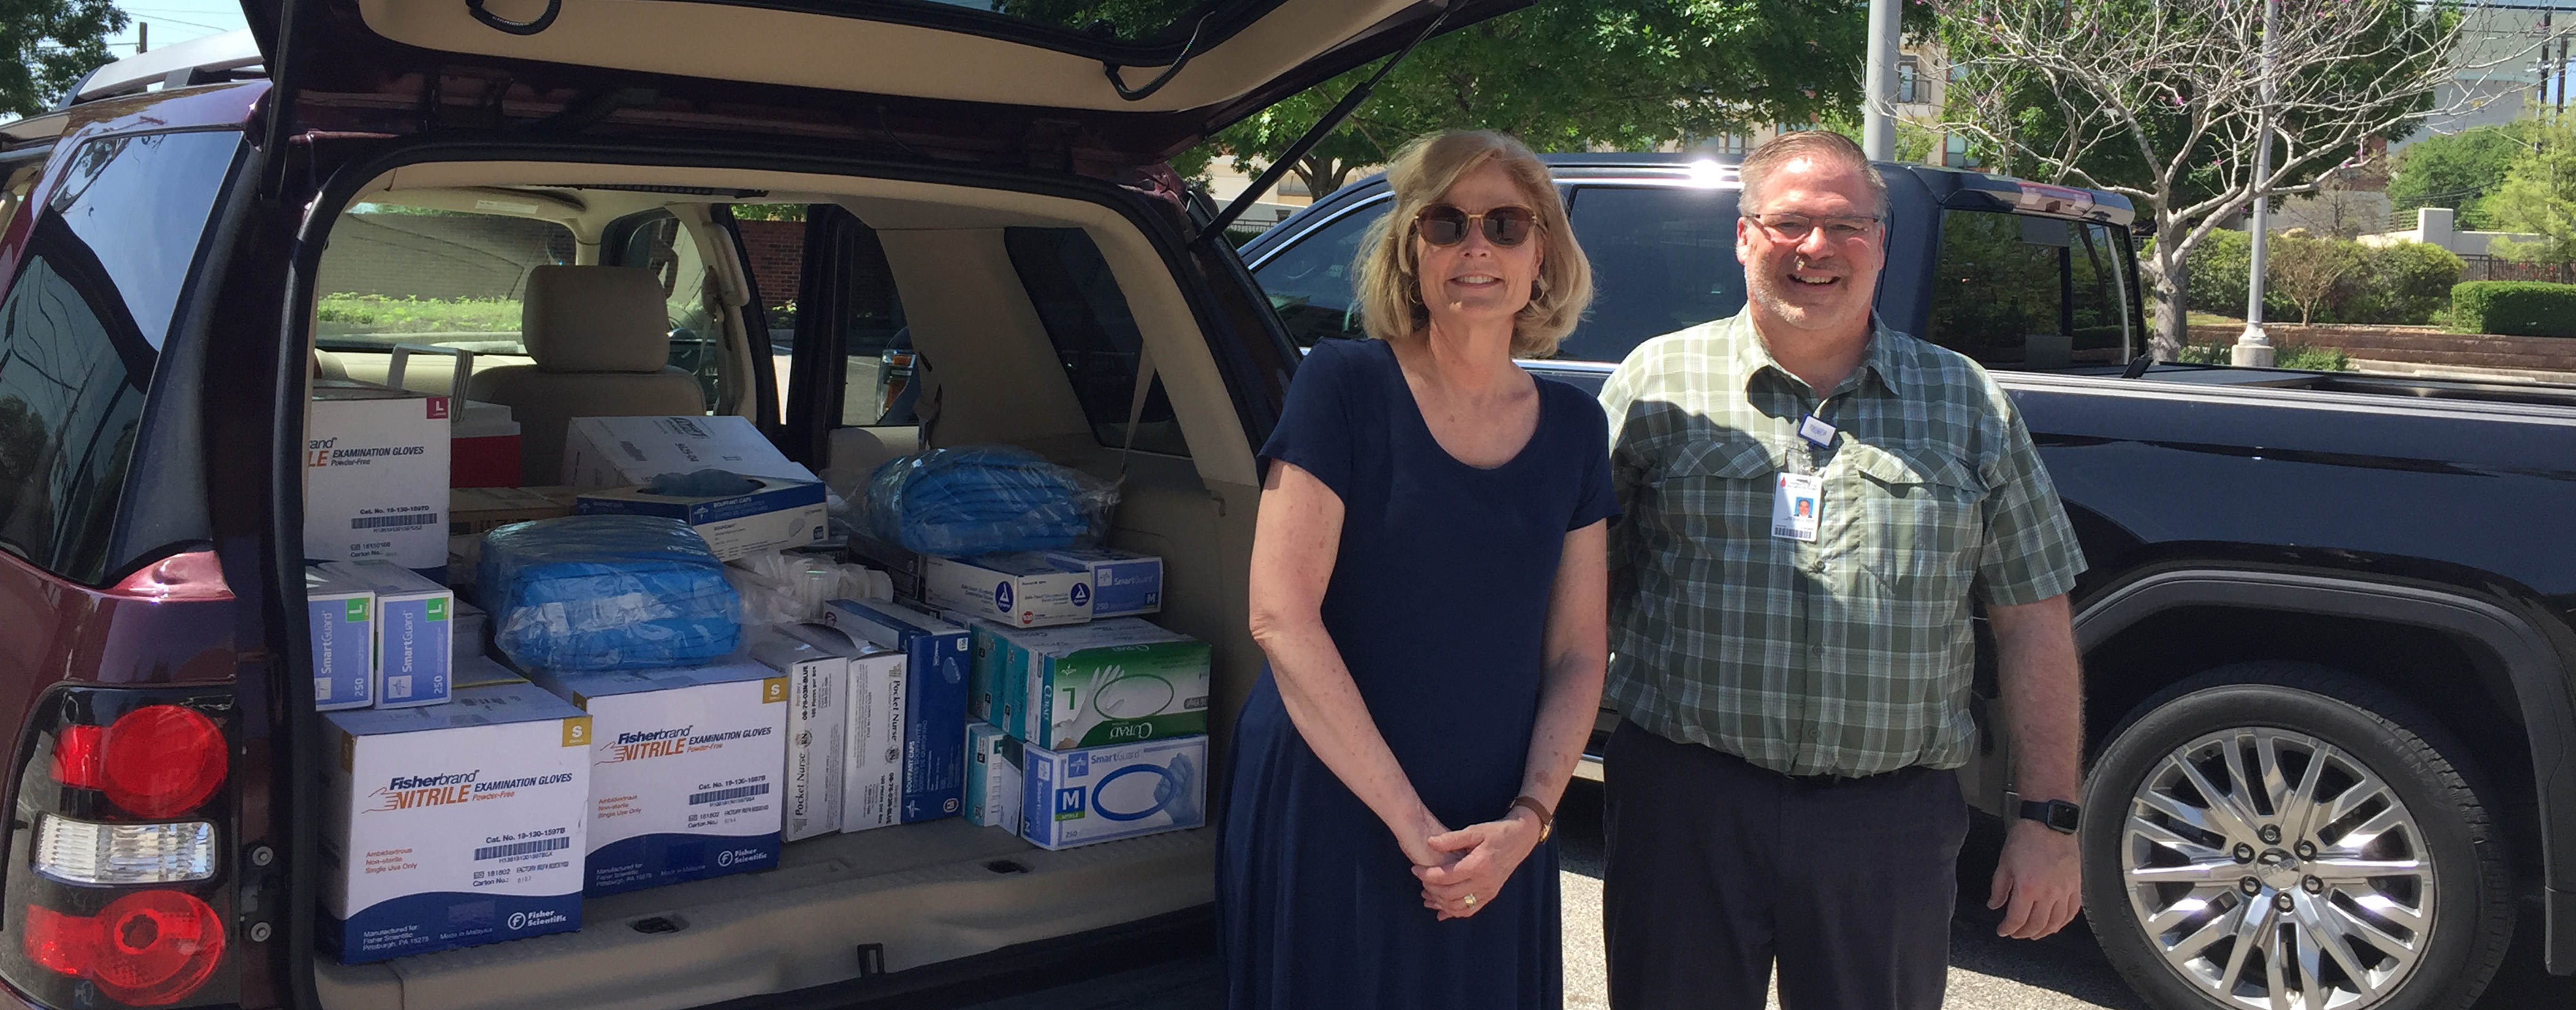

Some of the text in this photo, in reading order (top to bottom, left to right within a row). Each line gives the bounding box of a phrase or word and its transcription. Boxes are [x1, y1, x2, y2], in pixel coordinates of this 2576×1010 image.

[436, 401, 443, 411] L
[333, 447, 424, 458] EXAMINATION GLOVES
[331, 458, 370, 466] Powder-Free
[1147, 594, 1156, 603] M
[349, 605, 362, 614] L
[429, 604, 442, 614] L
[321, 612, 332, 673] SmartGuard
[402, 612, 413, 672] SmartGuard
[355, 678, 364, 696] 250
[434, 675, 443, 694] 250
[771, 684, 781, 696] S
[1062, 687, 1076, 710] L
[891, 680, 900, 742] Pocket Nurse
[572, 725, 582, 737] S
[618, 726, 691, 745] Fisherbrand
[688, 727, 772, 745] EXAMINATION GLOVES
[1109, 723, 1153, 739] CURAD
[622, 737, 687, 761] NITRILE
[1090, 749, 1140, 764] SmartGuard
[390, 770, 477, 790] Fisherbrand
[475, 773, 573, 792] EXAMINATION GLOVES
[795, 753, 805, 816] Pocket Nurse
[396, 785, 471, 810] NITRILE
[472, 791, 515, 802] Powder-Free
[1062, 789, 1079, 810] M
[366, 848, 413, 858] Ambidextrous
[734, 849, 757, 857] Fisher
[734, 852, 767, 864] Scientific
[365, 857, 403, 865] Non-sterile
[527, 910, 555, 919] Fisher
[527, 915, 567, 927] Scientific
